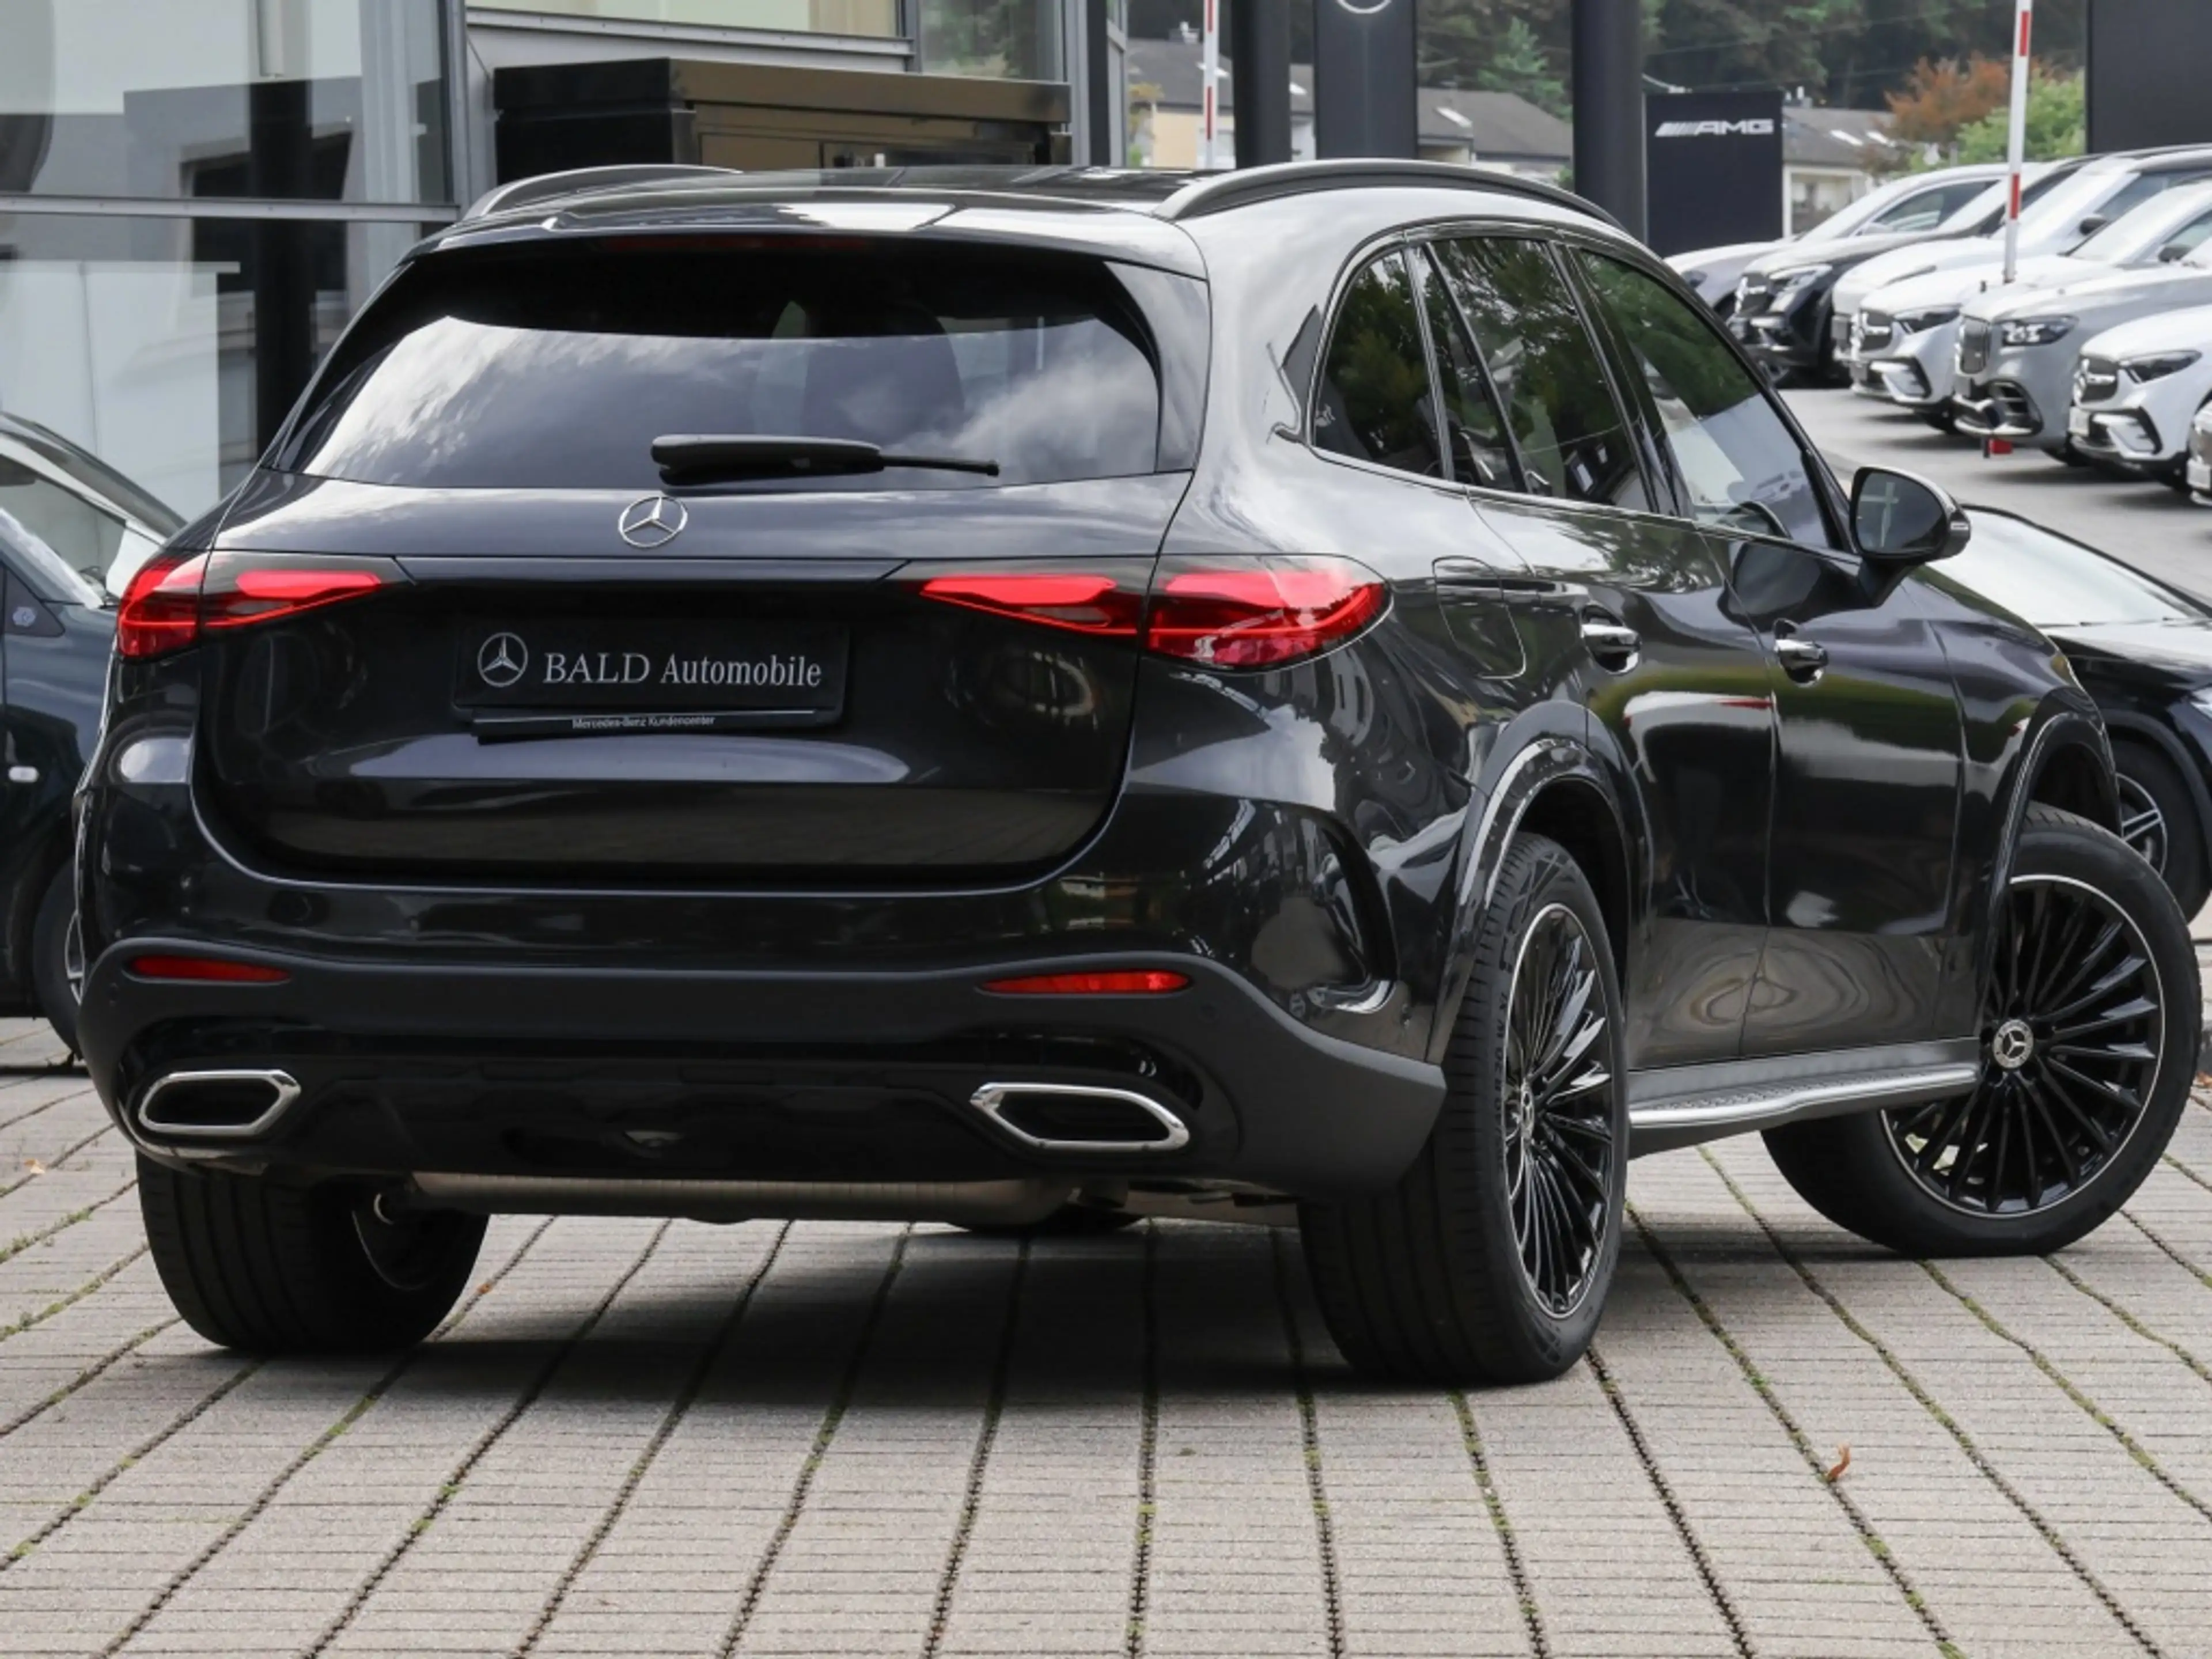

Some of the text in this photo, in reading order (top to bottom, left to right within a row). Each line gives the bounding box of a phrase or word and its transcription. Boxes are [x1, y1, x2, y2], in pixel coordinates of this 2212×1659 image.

[1694, 119, 1774, 135] AMG
[542, 652, 822, 687] BALD Automobile
[572, 715, 646, 729] Mercedes-Benz
